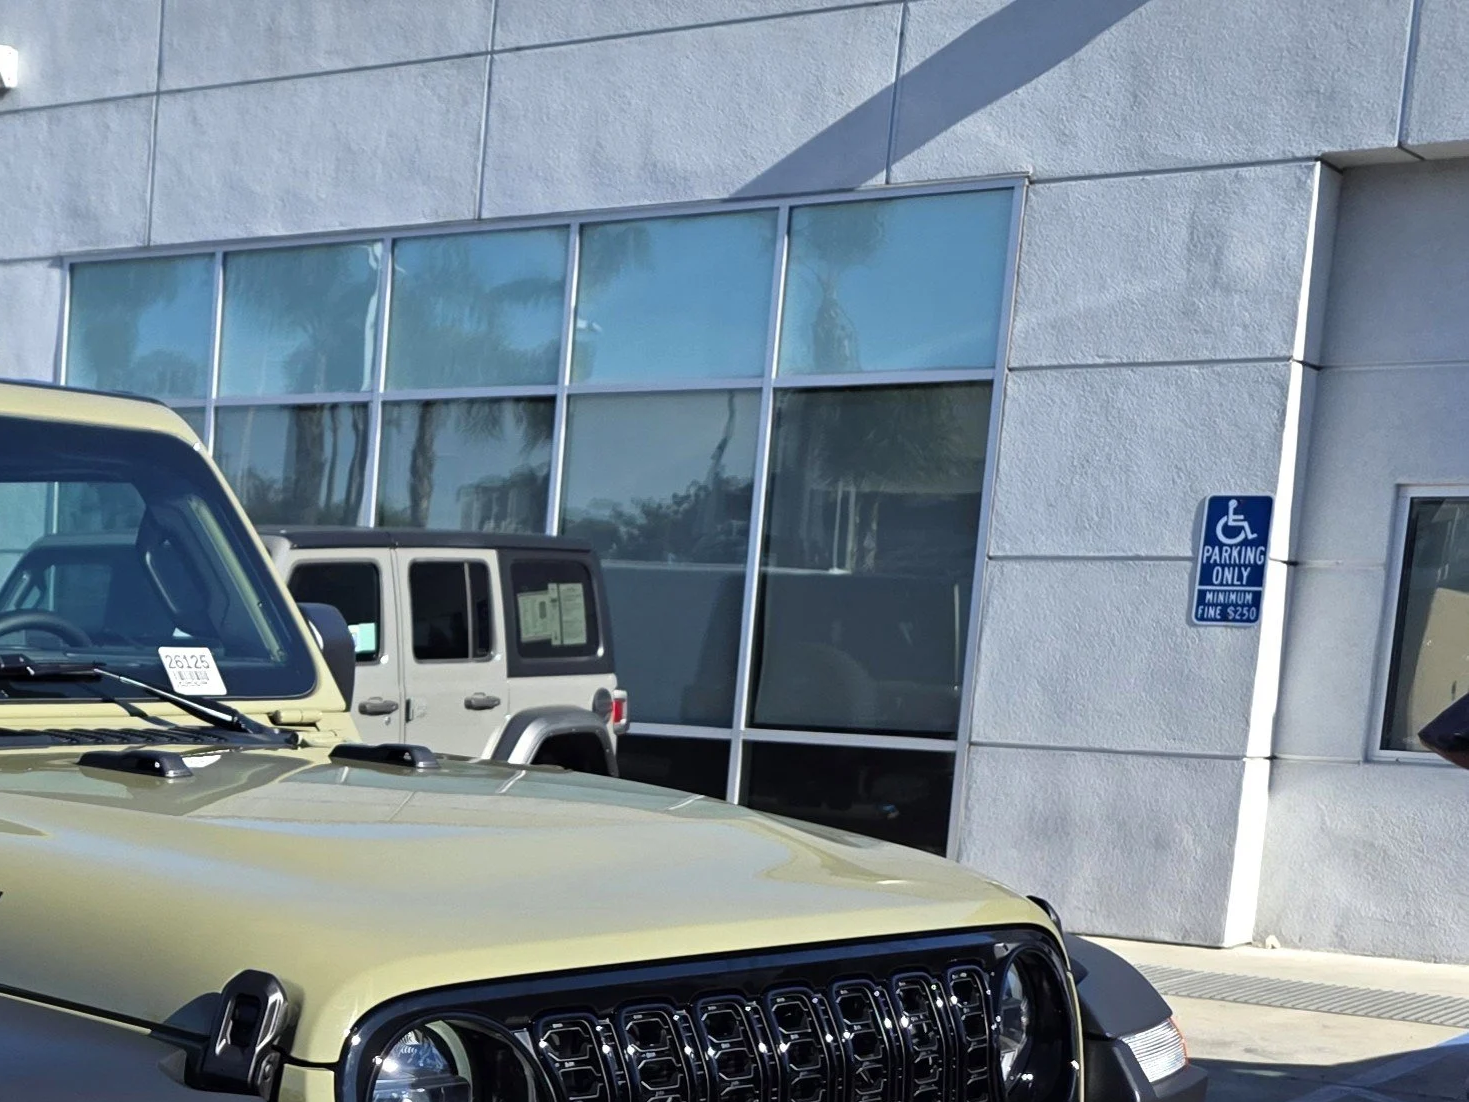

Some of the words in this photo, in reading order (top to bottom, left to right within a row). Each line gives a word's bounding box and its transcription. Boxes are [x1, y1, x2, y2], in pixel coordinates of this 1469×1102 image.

[1202, 545, 1266, 565] PARKING
[1212, 566, 1251, 585] ONLY
[1205, 591, 1253, 605] MINIMUM
[1197, 605, 1222, 619] FINE
[1227, 606, 1257, 620] $250
[165, 654, 210, 669] 26125
